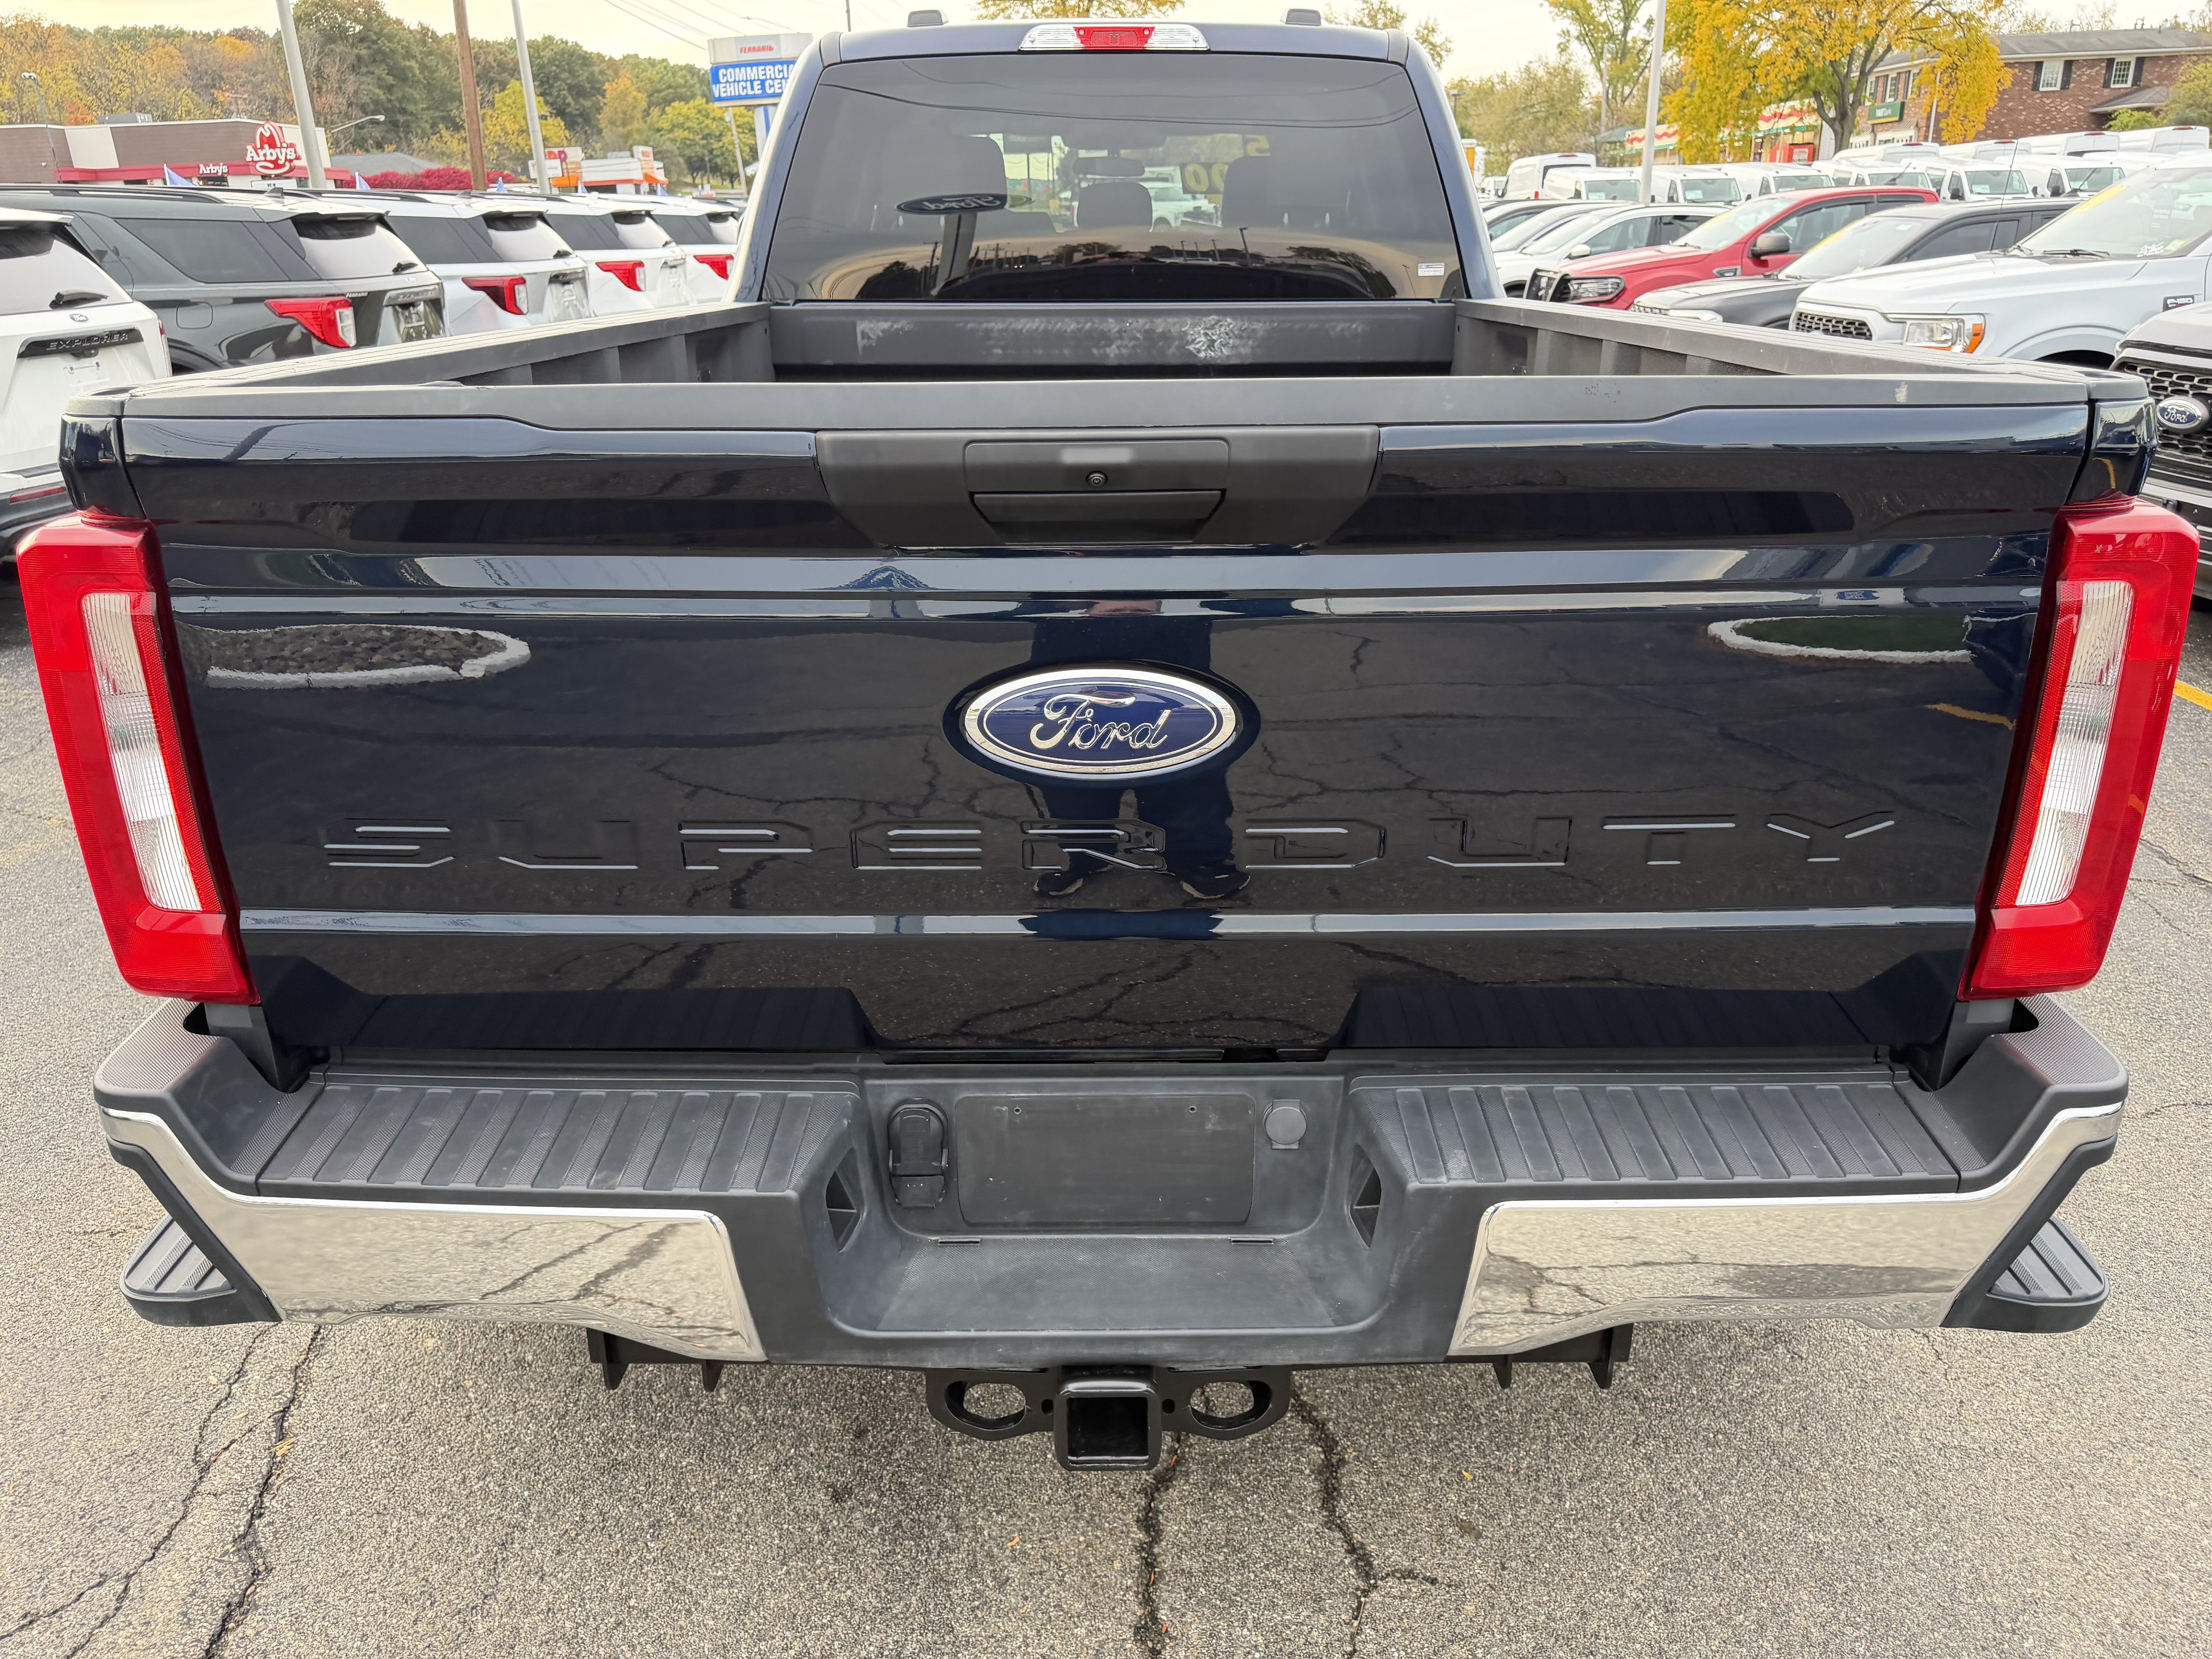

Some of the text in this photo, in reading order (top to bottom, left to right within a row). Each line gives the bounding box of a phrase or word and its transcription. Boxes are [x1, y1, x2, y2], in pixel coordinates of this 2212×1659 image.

[712, 81, 762, 98] VEHICLE
[246, 142, 296, 164] Arby's
[199, 163, 228, 175] Arby's
[46, 331, 129, 350] EXPLORER
[2164, 405, 2190, 423] Ford
[1030, 694, 1172, 750] Ford
[323, 811, 1895, 870] SUPER DUTY
